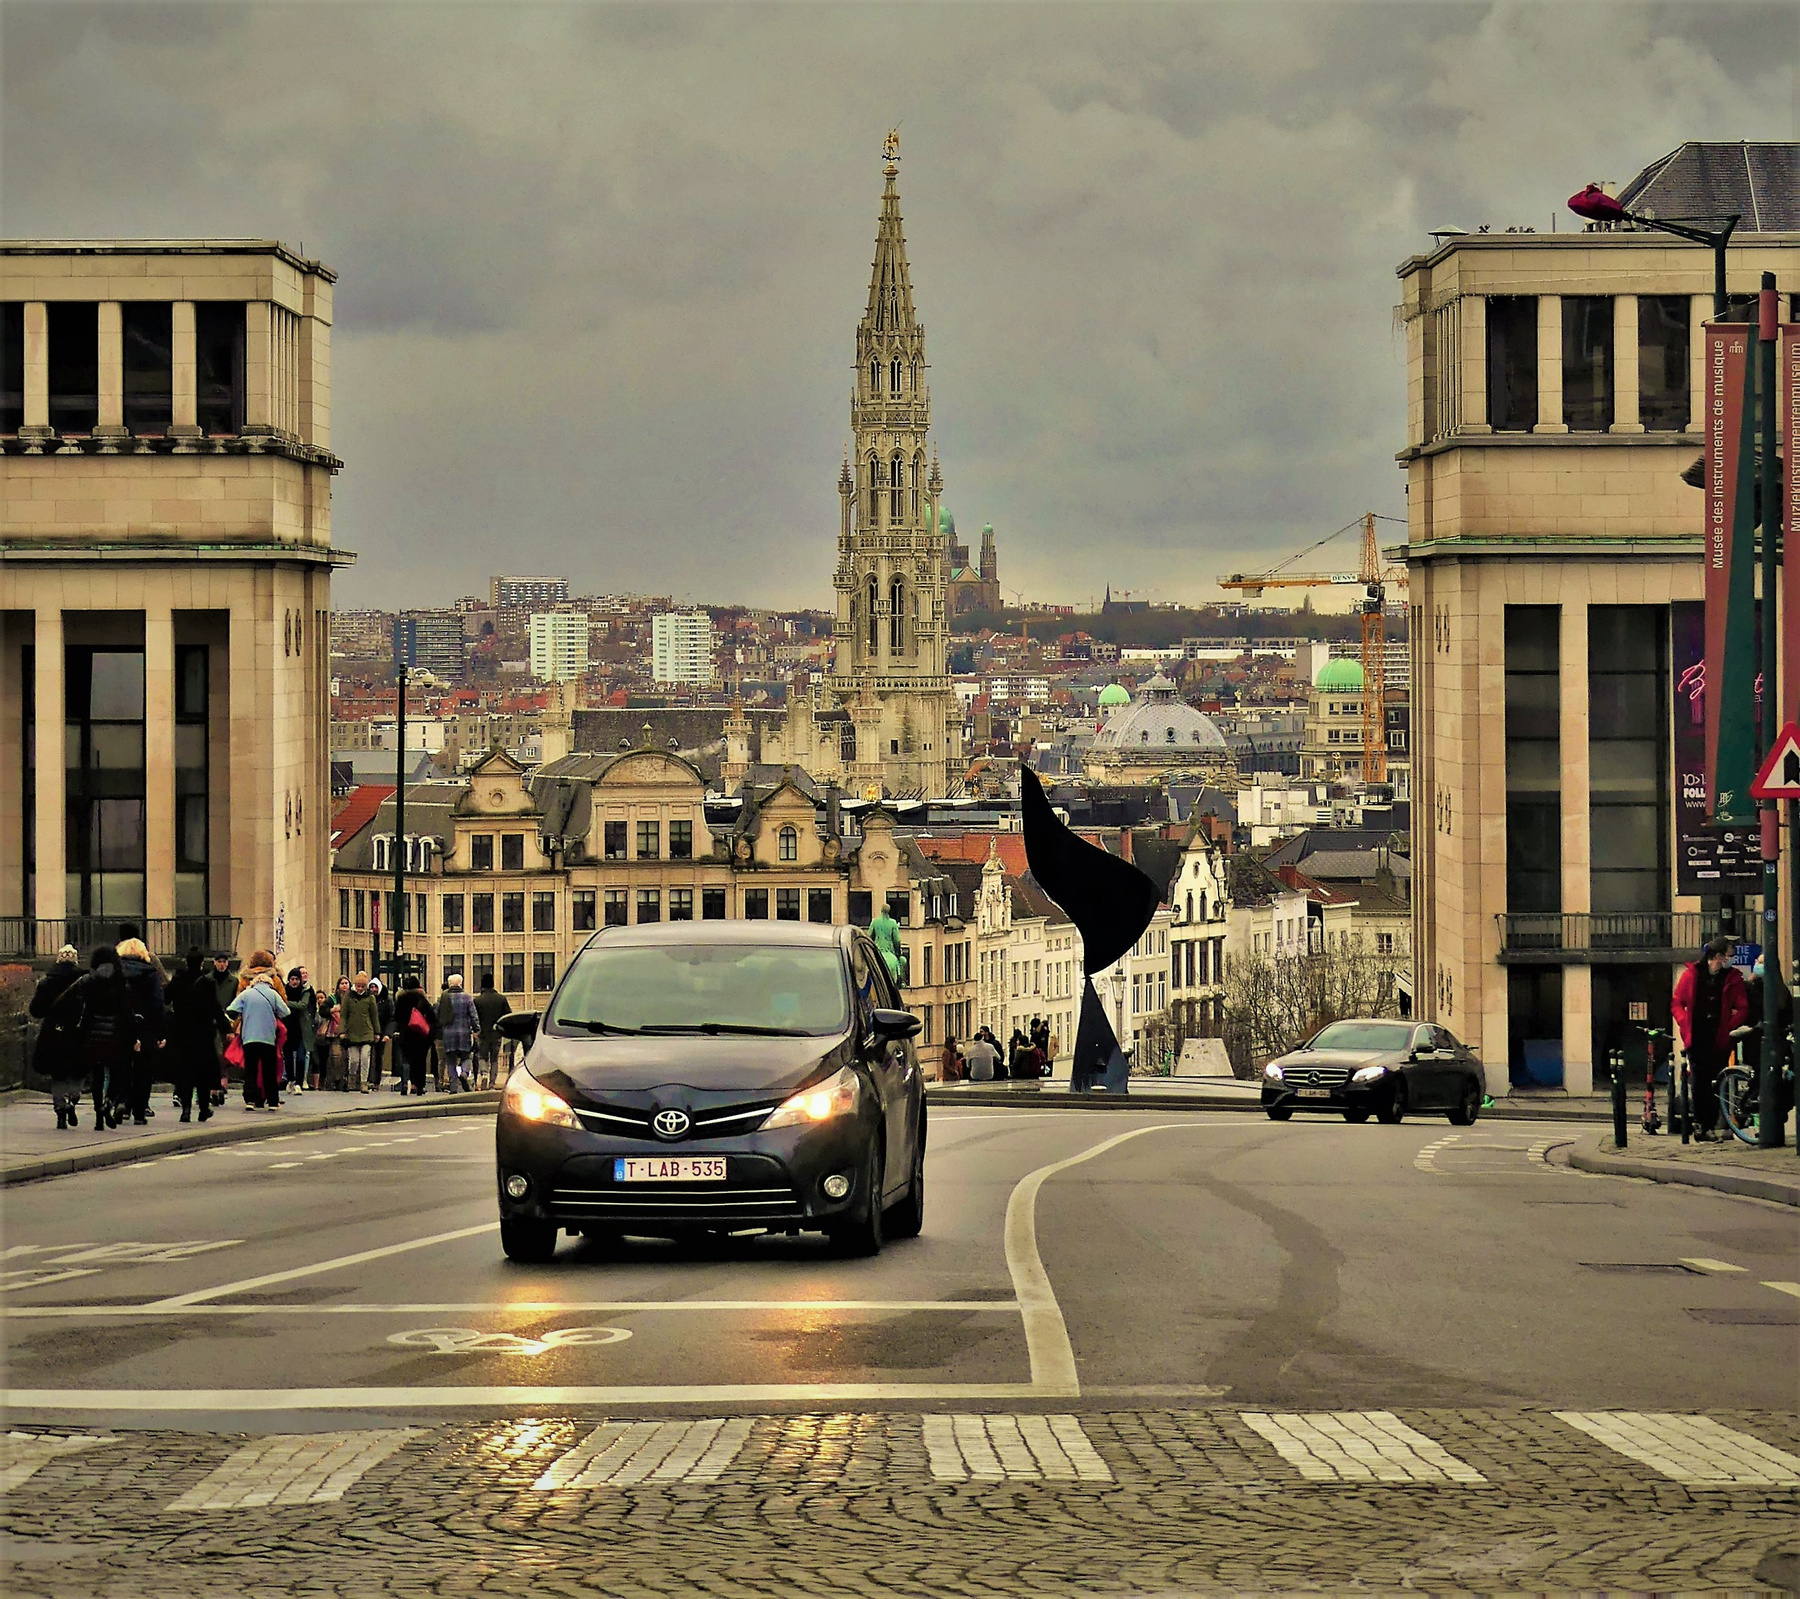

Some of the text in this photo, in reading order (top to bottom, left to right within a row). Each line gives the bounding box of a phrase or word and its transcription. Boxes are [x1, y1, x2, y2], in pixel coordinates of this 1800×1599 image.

[1712, 340, 1725, 569] Musée des instruments de musique
